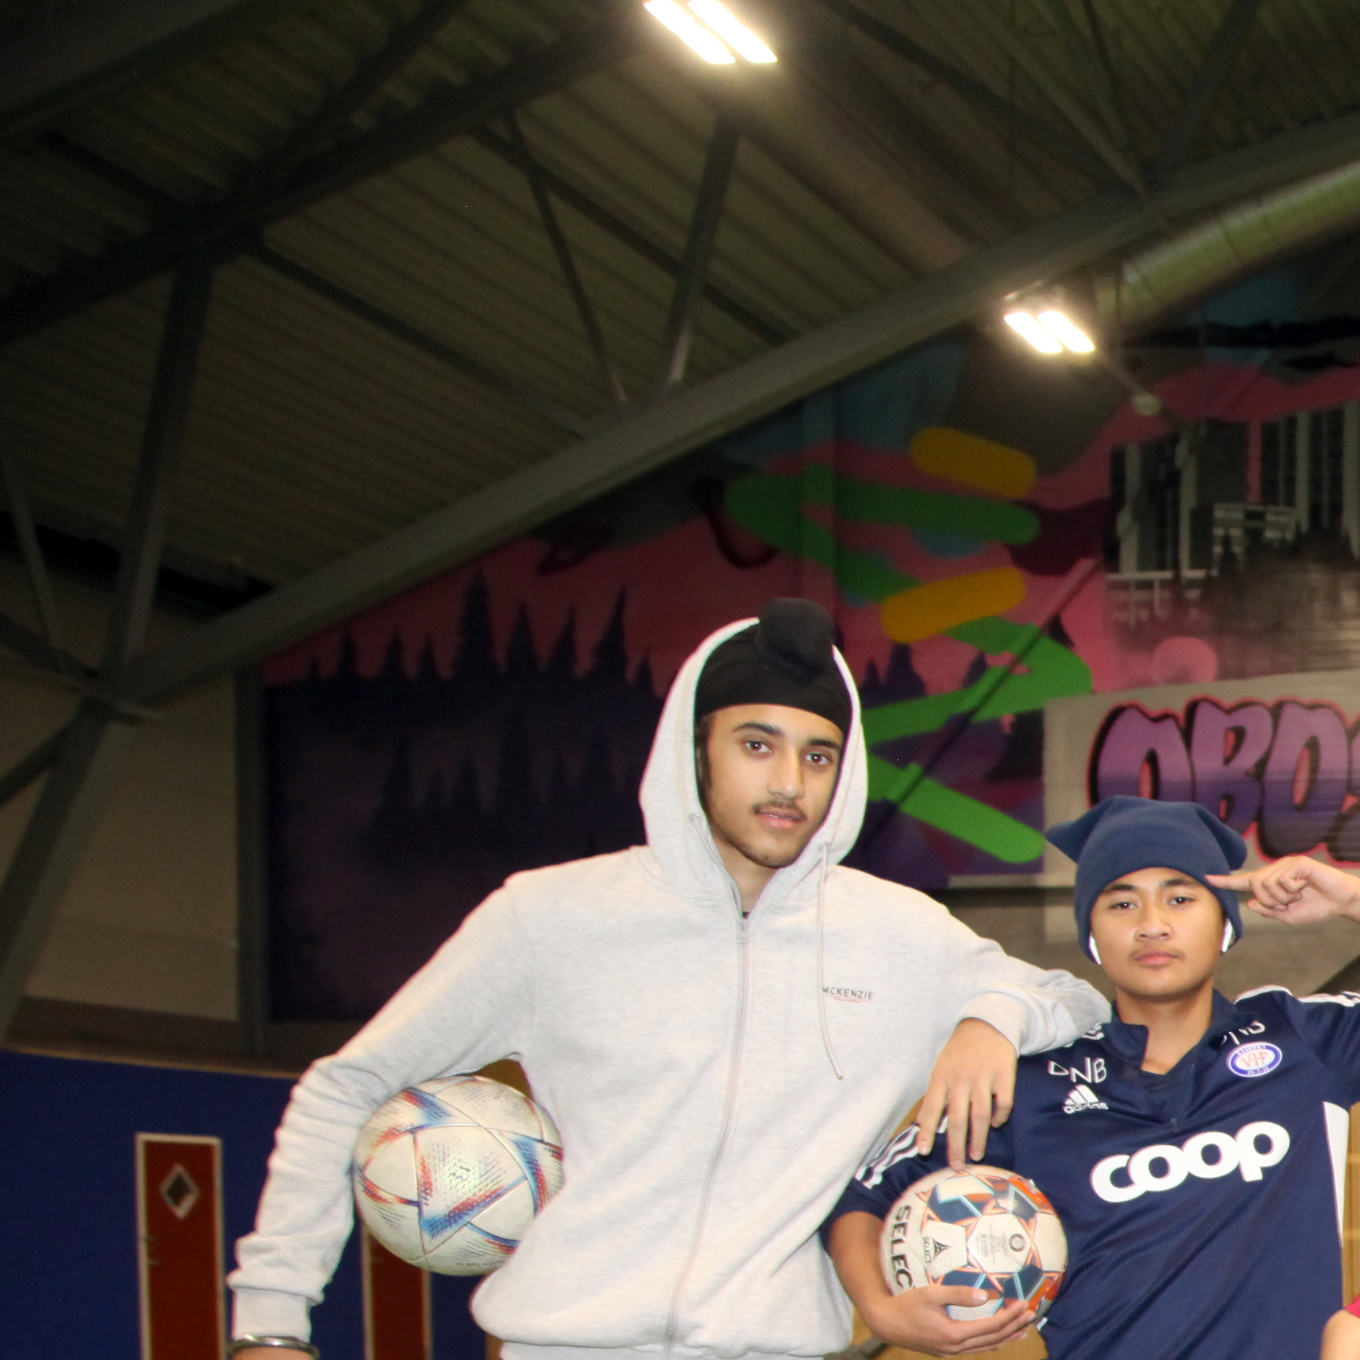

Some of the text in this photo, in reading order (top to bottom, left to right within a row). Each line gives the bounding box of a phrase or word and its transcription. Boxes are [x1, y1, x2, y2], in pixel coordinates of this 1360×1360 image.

[821, 986, 874, 1001] MCKENZIE
[1047, 1056, 1108, 1084] DNB
[1089, 1121, 1291, 1204] coop
[891, 1205, 916, 1289] SELEC
